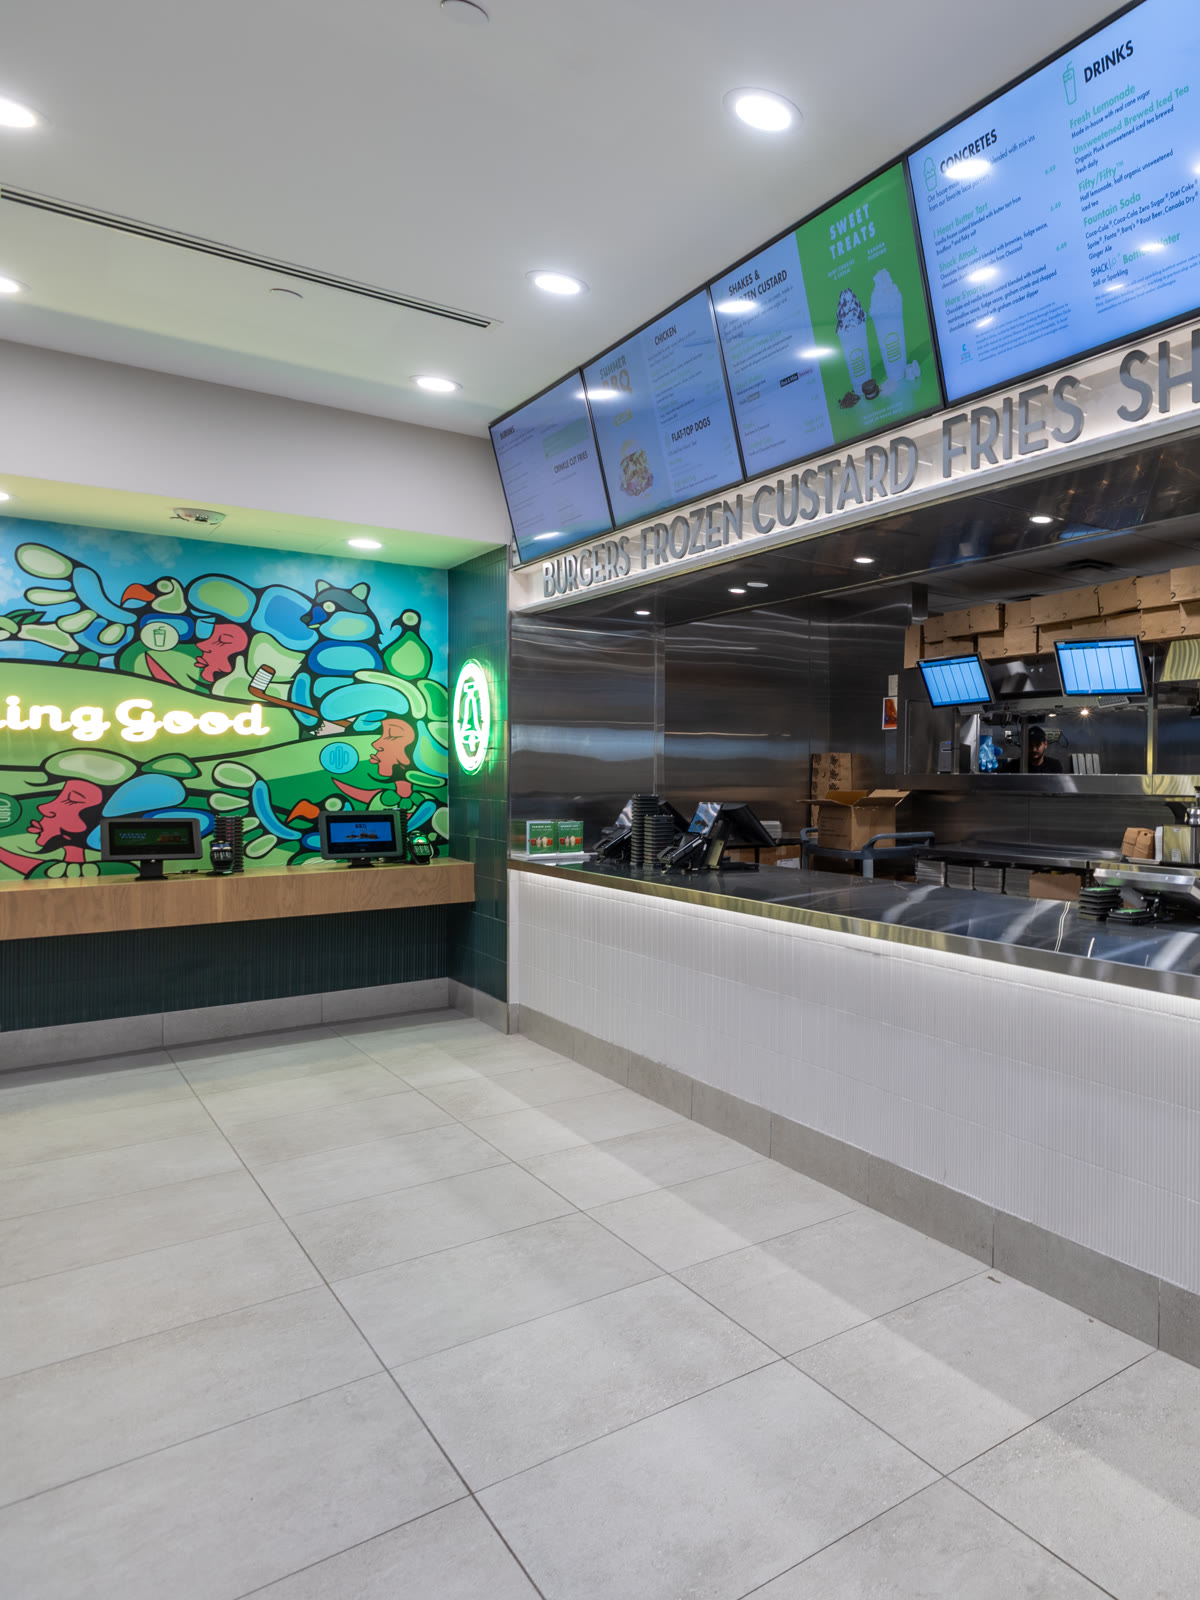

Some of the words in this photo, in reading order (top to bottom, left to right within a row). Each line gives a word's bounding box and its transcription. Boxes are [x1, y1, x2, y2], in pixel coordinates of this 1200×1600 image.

[1084, 40, 1134, 83] DRINKS
[1069, 109, 1091, 129] Fresh
[1092, 84, 1135, 116] Lemonade
[1071, 127, 1084, 139] Made
[1085, 117, 1104, 131] in-house
[1104, 110, 1114, 119] with
[1114, 103, 1124, 114] real
[1124, 98, 1136, 108] cane
[1137, 90, 1150, 101] sugar
[1073, 120, 1122, 155] Unsweetened
[1124, 101, 1154, 127] Brewed
[1156, 91, 1173, 109] Iced
[1174, 85, 1189, 98] Tea
[940, 128, 997, 172] CONCRETES
[1074, 151, 1093, 164] Organic
[1093, 143, 1105, 154] Pluck
[1105, 126, 1135, 148] unsweetened
[1135, 120, 1146, 131] iced
[1146, 117, 1155, 125] tea
[1155, 104, 1174, 120] brewed
[1076, 164, 1087, 175] fresh
[1087, 158, 1098, 169] daily
[1080, 191, 1089, 202] Half
[1090, 181, 1112, 197] lemonade,
[1113, 174, 1123, 184] half
[1124, 166, 1141, 180] organic
[1142, 148, 1173, 170] unsweetened
[829, 203, 869, 241] SWEET
[936, 220, 954, 237] Heart
[954, 211, 974, 227] Butter
[975, 202, 988, 215] Tart
[1082, 202, 1091, 212] iced
[1083, 204, 1118, 227] Fountain
[1119, 192, 1141, 210] Soda
[1113, 209, 1138, 227] Coca-Cola
[1139, 205, 1150, 214] Zero
[1170, 189, 1180, 200] Diet
[1140, 215, 1151, 224] Root
[1151, 210, 1165, 220] Beer,
[1164, 199, 1185, 214] Canada
[829, 222, 876, 261] TREATS
[939, 256, 957, 272] Shack
[958, 245, 978, 262] Attack
[1088, 249, 1104, 260] Ginger
[1104, 245, 1112, 253] Ale
[729, 273, 753, 296] SHAKES
[754, 269, 760, 280] &
[758, 270, 787, 295] CUSTARD
[1092, 278, 1101, 288] Still
[1107, 269, 1128, 281] Sparkling
[655, 325, 677, 345] CHICKEN
[599, 355, 627, 379] SUMMER
[672, 425, 694, 443] FLAT-TOP
[694, 417, 711, 432] DOGS
[553, 461, 569, 473] CRINKLE
[569, 456, 578, 466] CUT
[577, 451, 588, 461] FRIES
[543, 536, 630, 598] BURGERS
[640, 494, 743, 570] FROZEN
[752, 436, 918, 534] CUSTARD
[942, 376, 1085, 478] FRIES
[0, 696, 111, 741] ing
[115, 699, 270, 742] Good
